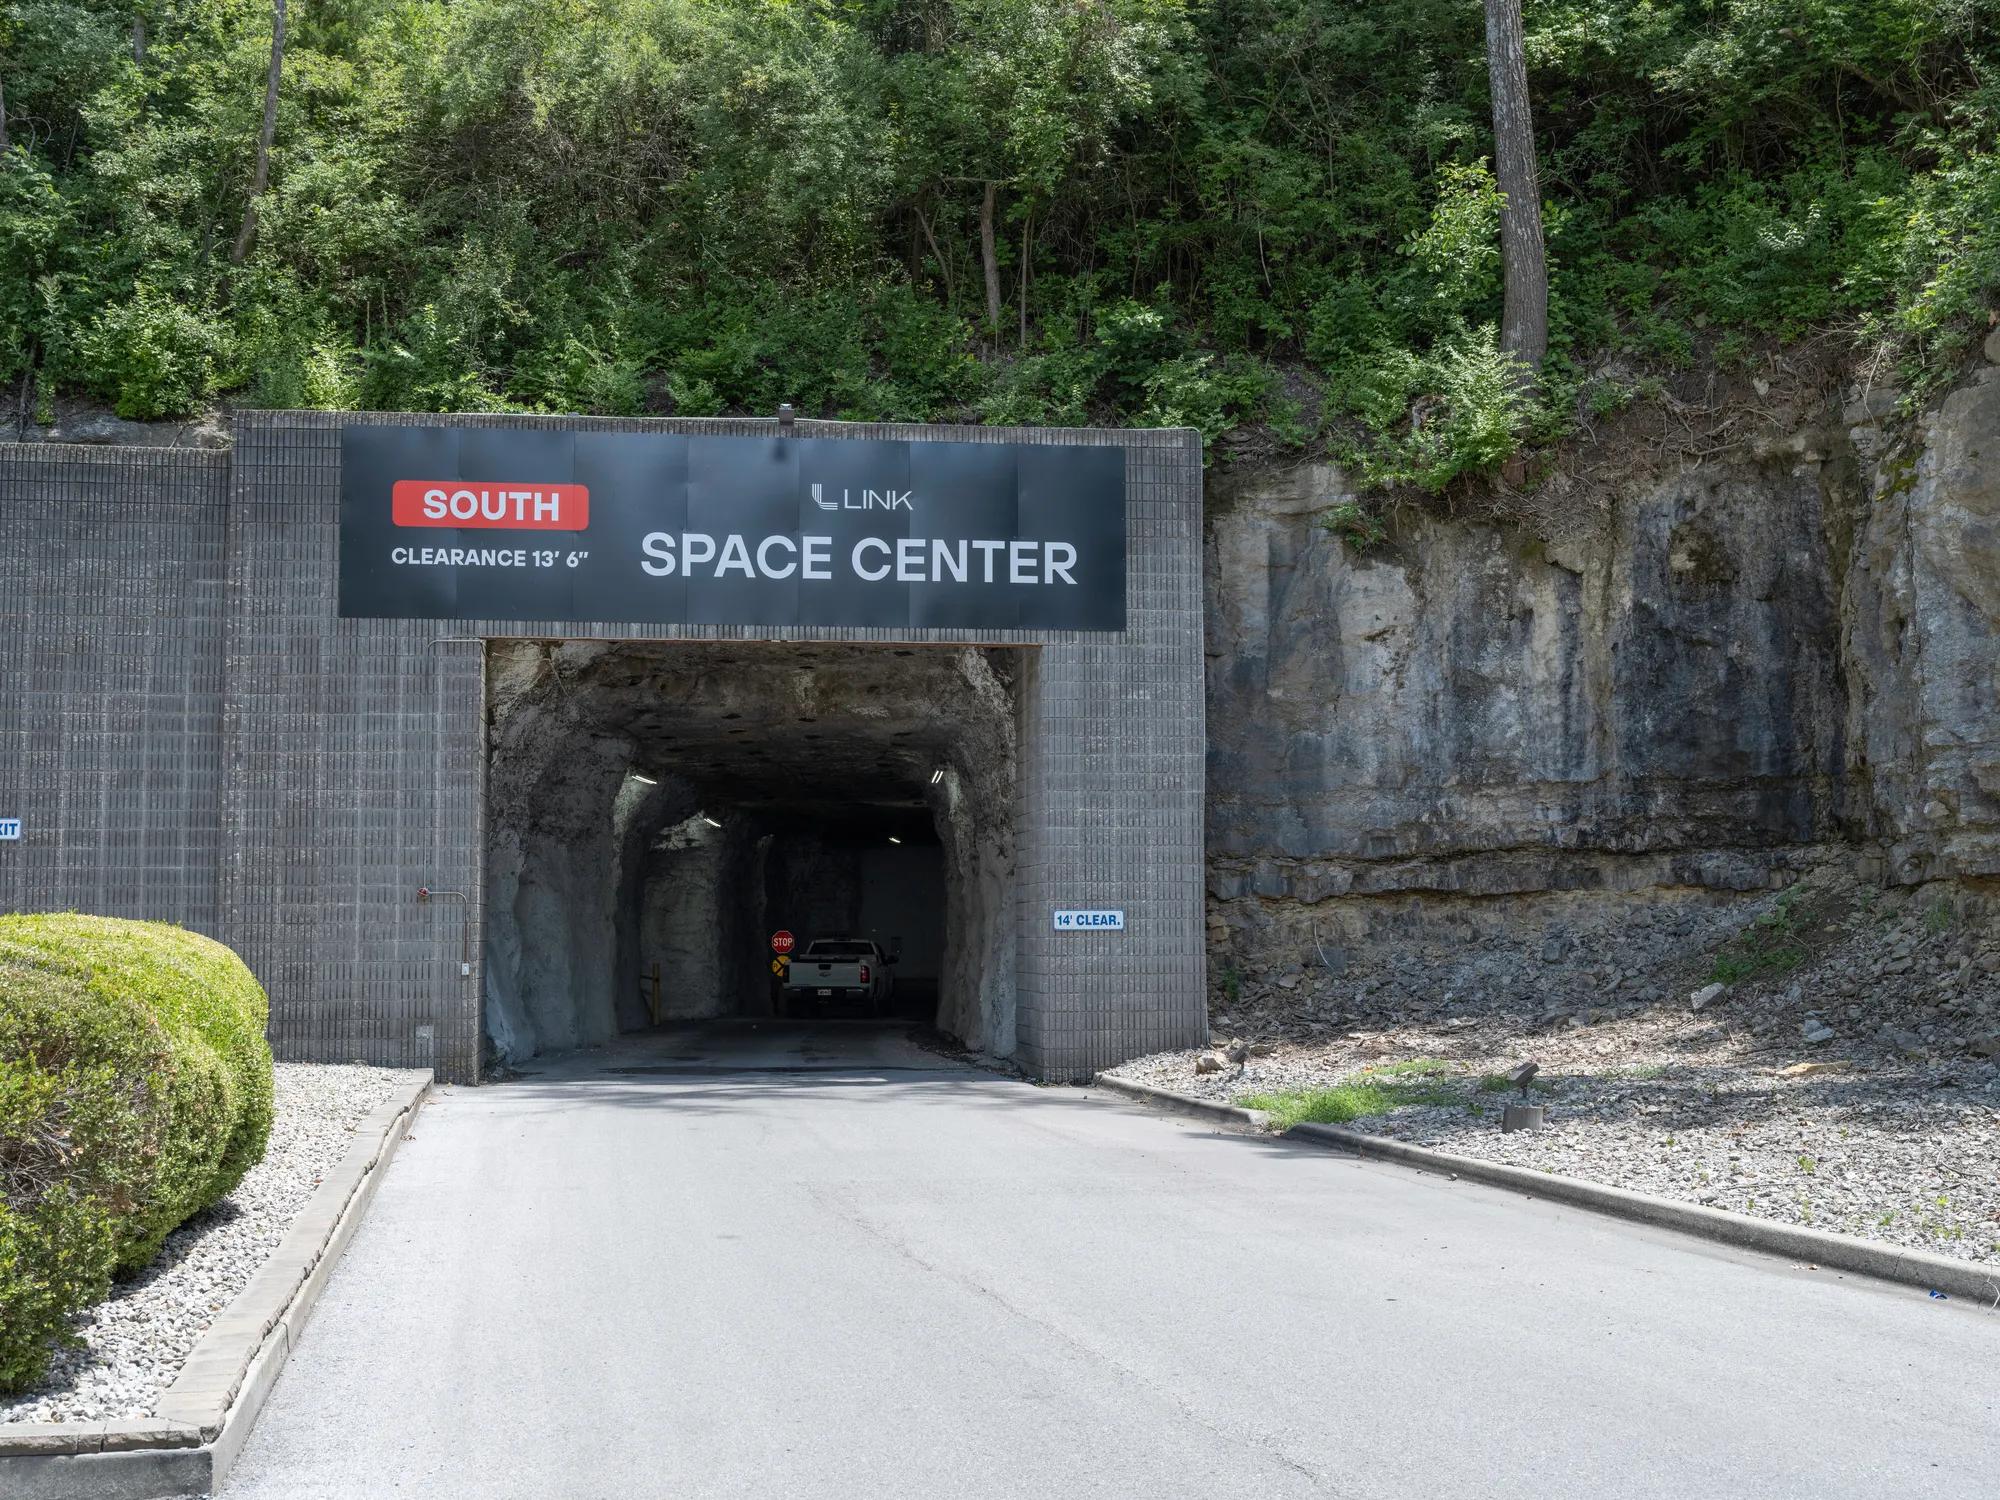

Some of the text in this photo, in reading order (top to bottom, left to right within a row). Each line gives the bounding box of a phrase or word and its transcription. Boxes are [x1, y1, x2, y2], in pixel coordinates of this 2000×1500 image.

[424, 490, 559, 521] SOUTH
[844, 489, 913, 510] LINK
[392, 547, 526, 567] CLEARANCE
[642, 532, 1077, 584] SPACE CENTER
[1057, 914, 1120, 926] 14' CLEAR.
[773, 938, 793, 947] STOP
